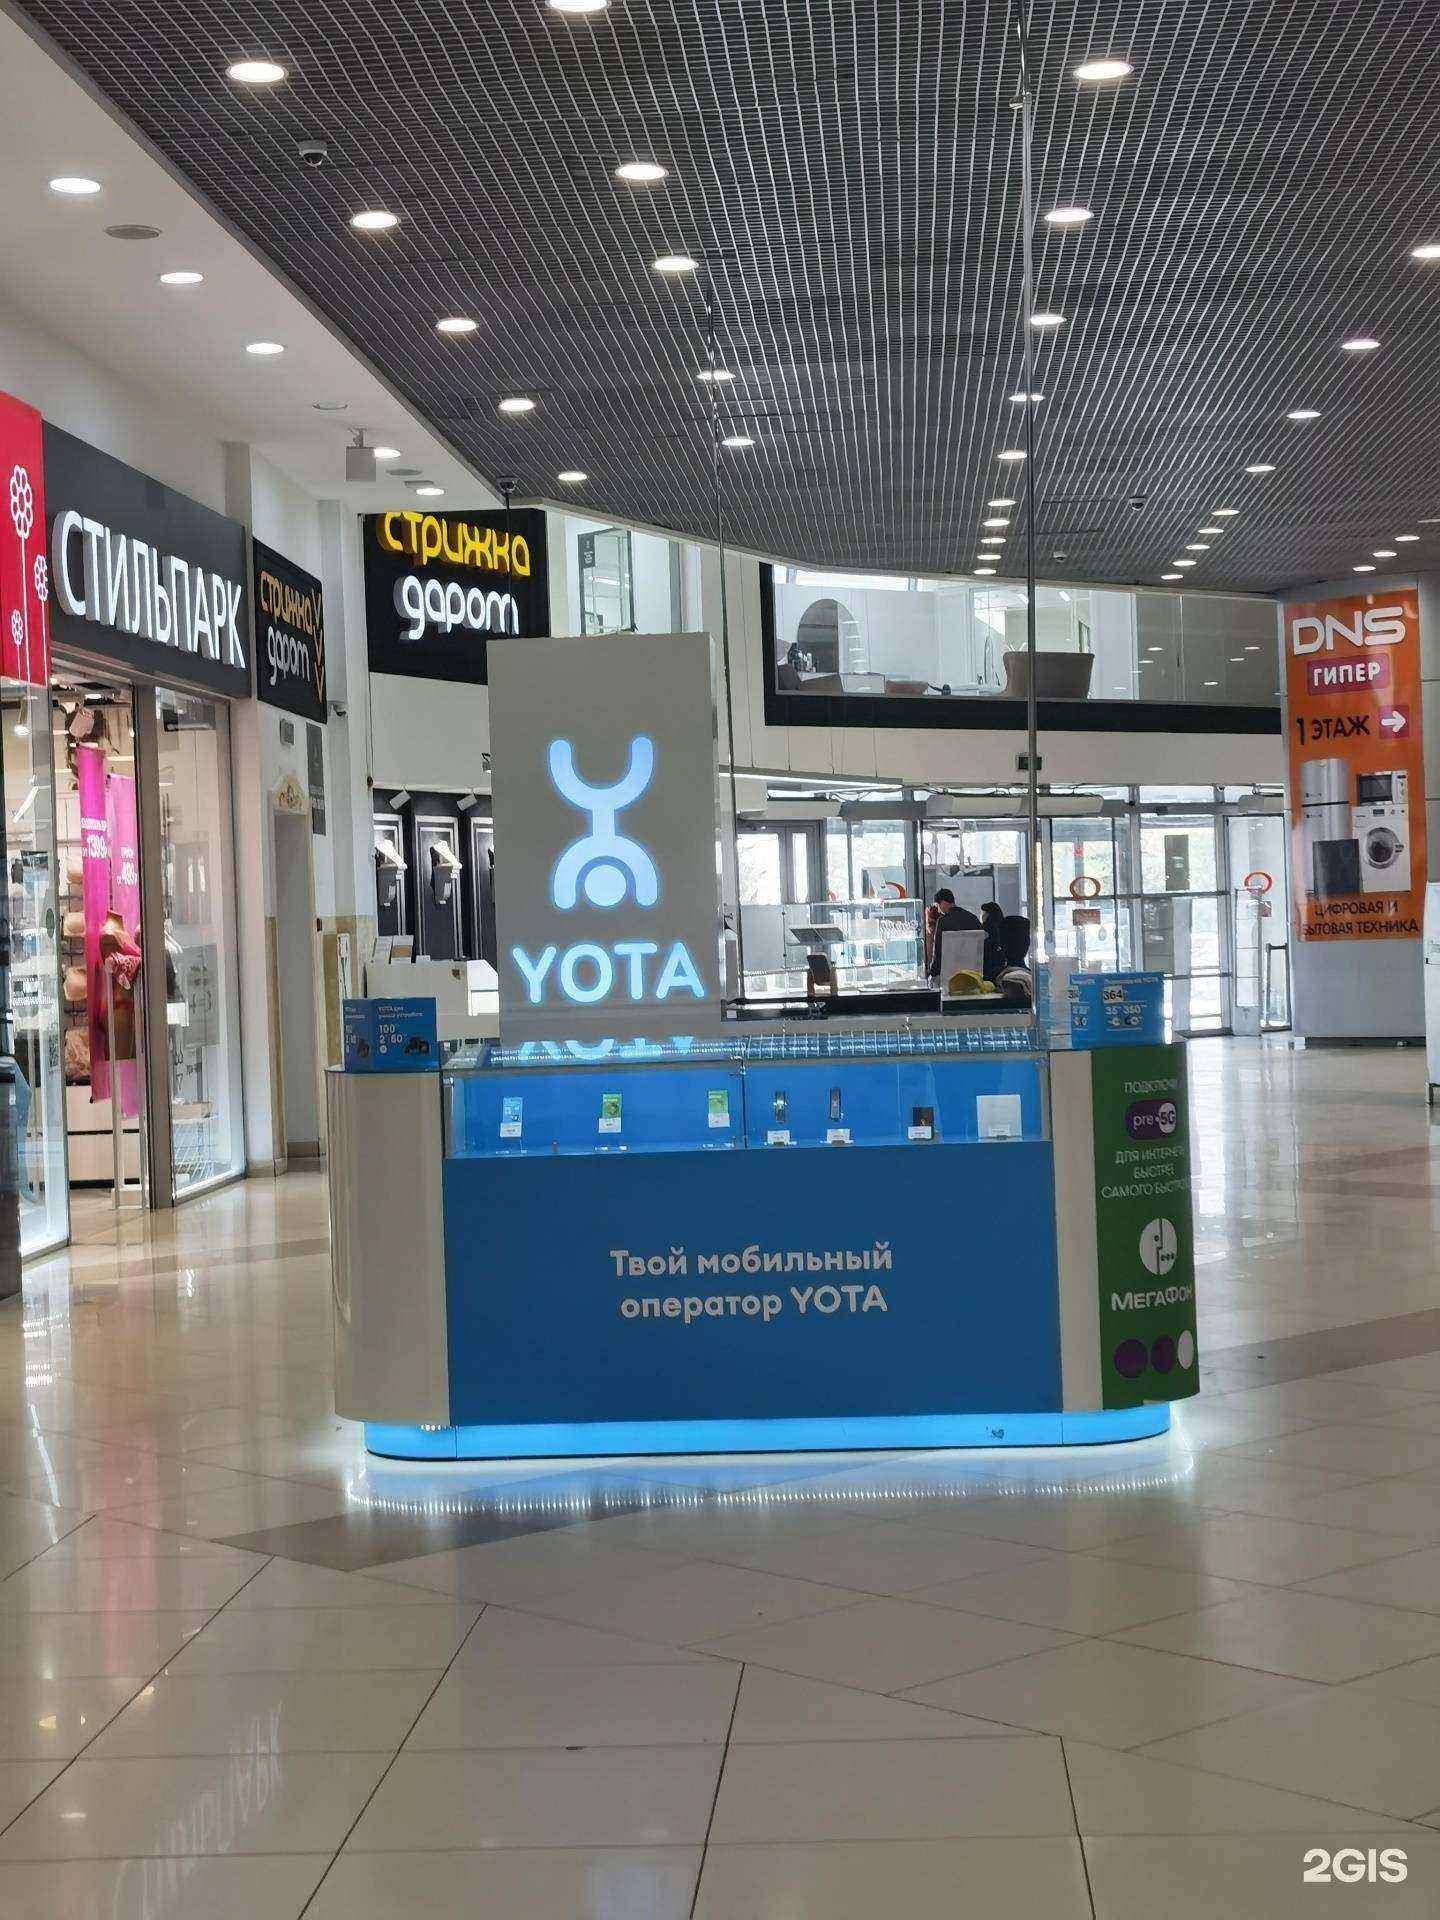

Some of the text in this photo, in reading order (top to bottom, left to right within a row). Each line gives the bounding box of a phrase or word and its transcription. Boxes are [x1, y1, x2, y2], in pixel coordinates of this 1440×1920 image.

[384, 511, 531, 577] стрижка
[52, 510, 246, 669] СТИЛЬПАРК
[1292, 606, 1406, 656] DNS
[1313, 661, 1382, 687] ГИПЕР
[1296, 715, 1371, 746] 1 ЭТАЖ
[1315, 901, 1399, 918] ЦИФРОВАЯ И
[1357, 918, 1420, 934] ТЕХНИКА
[511, 942, 706, 1004] YOTA
[1115, 1150, 1139, 1165] ДЛЯ
[1101, 1183, 1153, 1199] САМОГО
[610, 1241, 893, 1277] Твой мобильный
[621, 1285, 889, 1324] оператор YOTA
